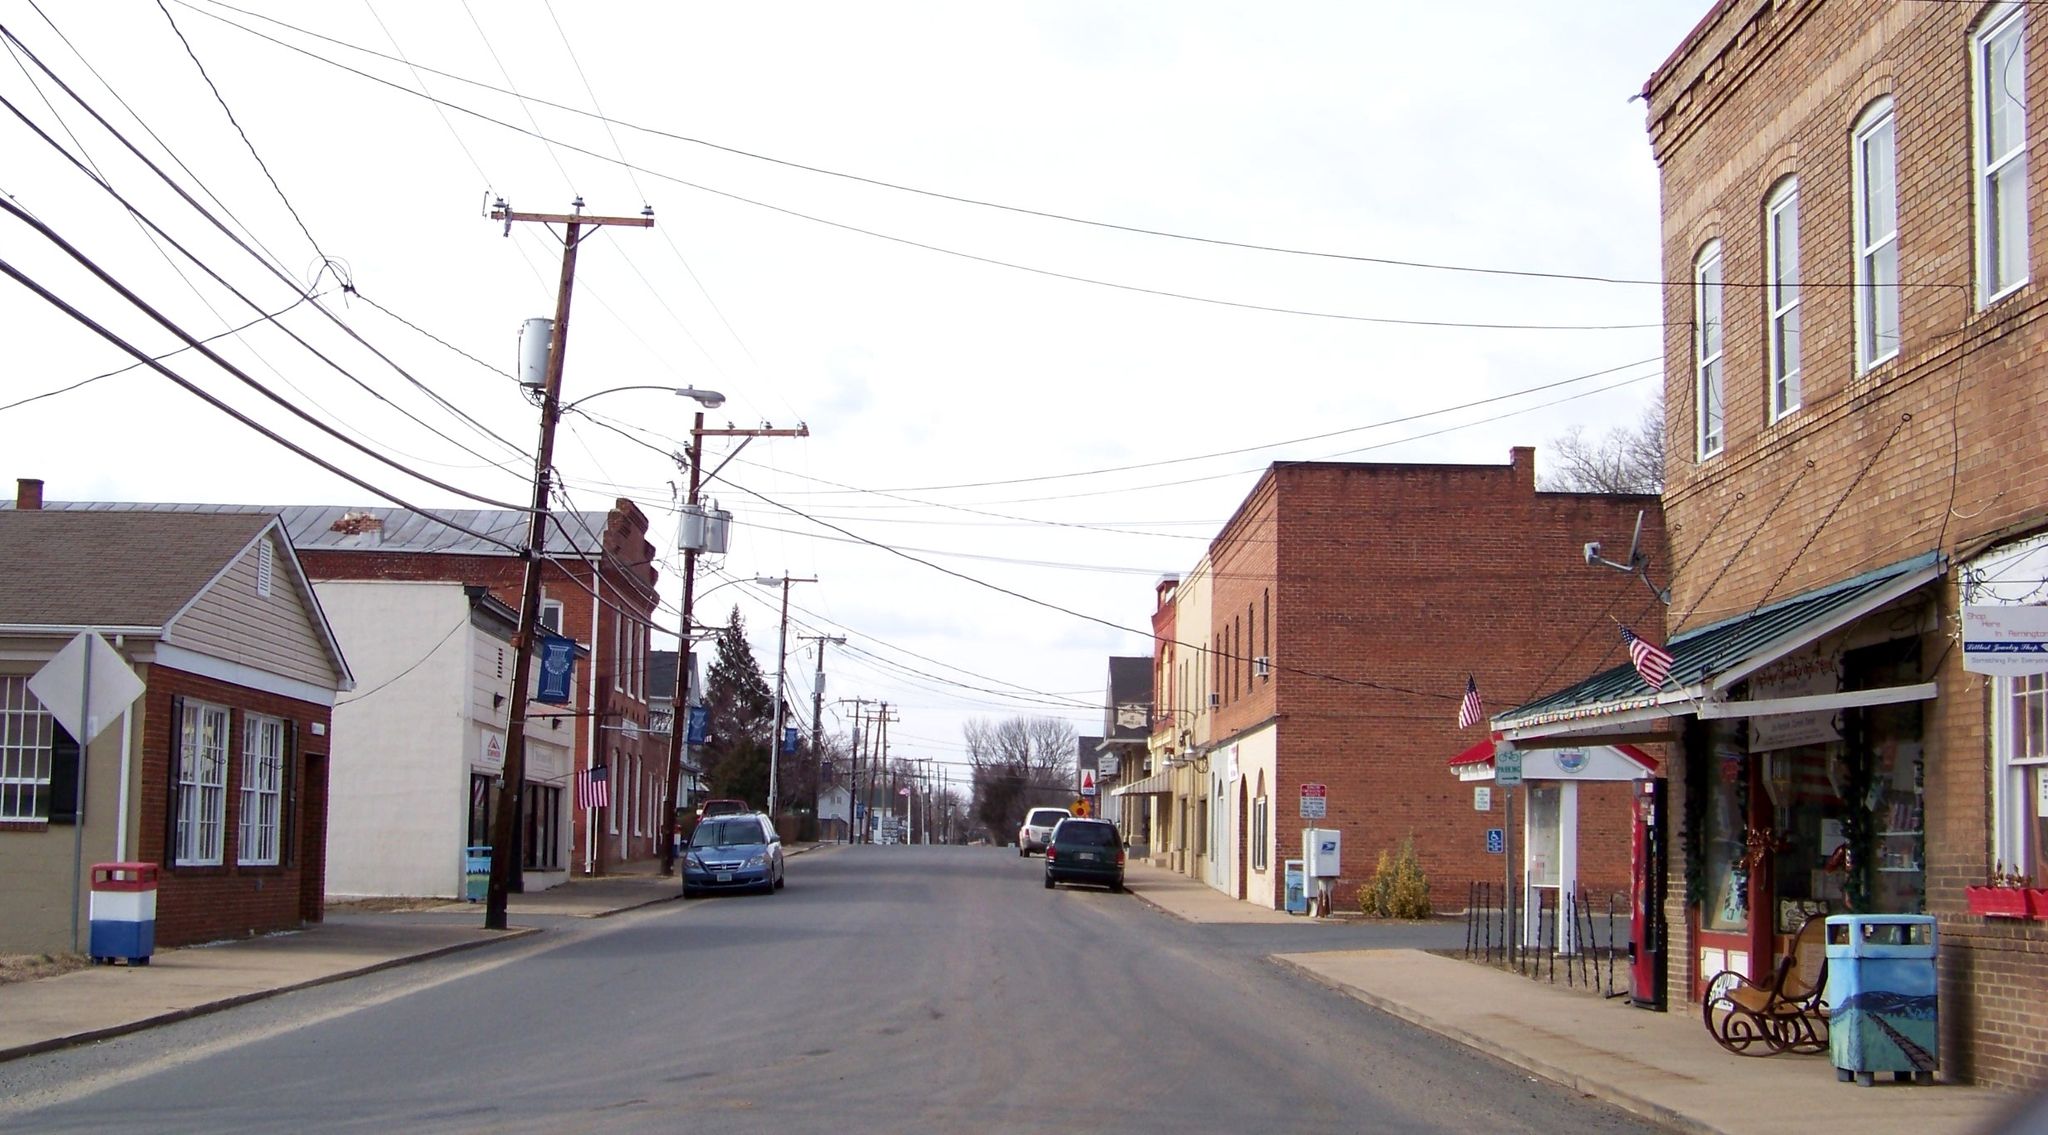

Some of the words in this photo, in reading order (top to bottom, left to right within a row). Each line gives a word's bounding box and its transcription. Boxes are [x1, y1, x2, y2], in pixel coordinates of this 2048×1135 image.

[1967, 612, 1986, 620] Shop
[1993, 643, 2019, 652] Jewelry
[2020, 643, 2038, 652] Shop
